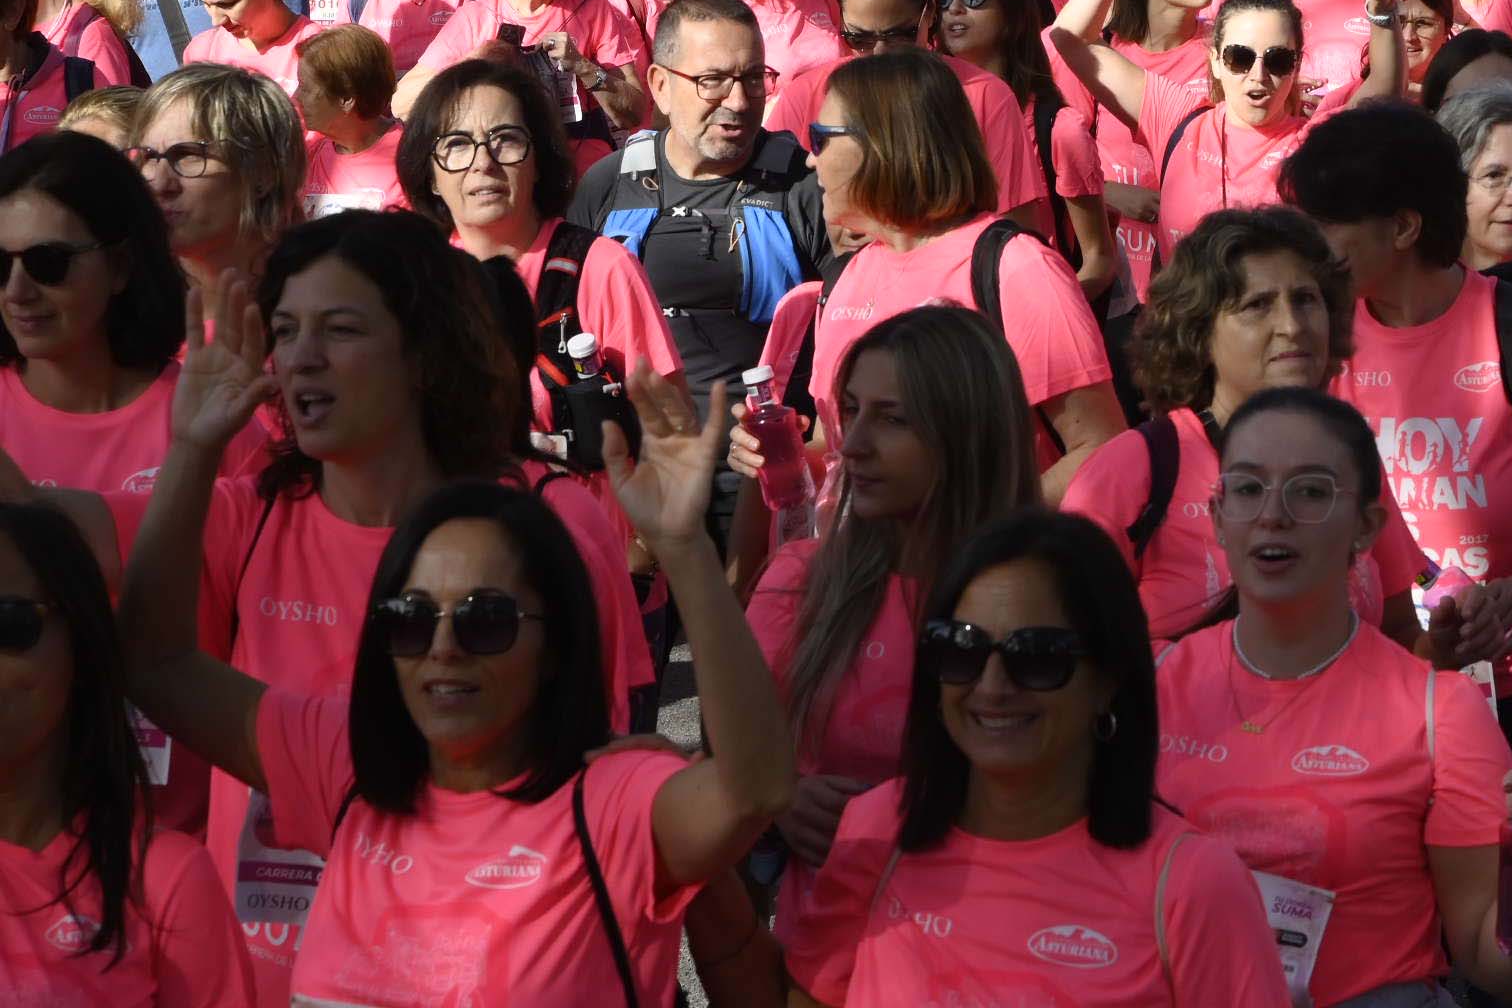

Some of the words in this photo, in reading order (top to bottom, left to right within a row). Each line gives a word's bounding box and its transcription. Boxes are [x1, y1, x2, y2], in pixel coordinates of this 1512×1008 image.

[260, 597, 338, 626] OYSHO
[256, 865, 315, 881] CARRERA
[246, 892, 310, 913] OYSHO
